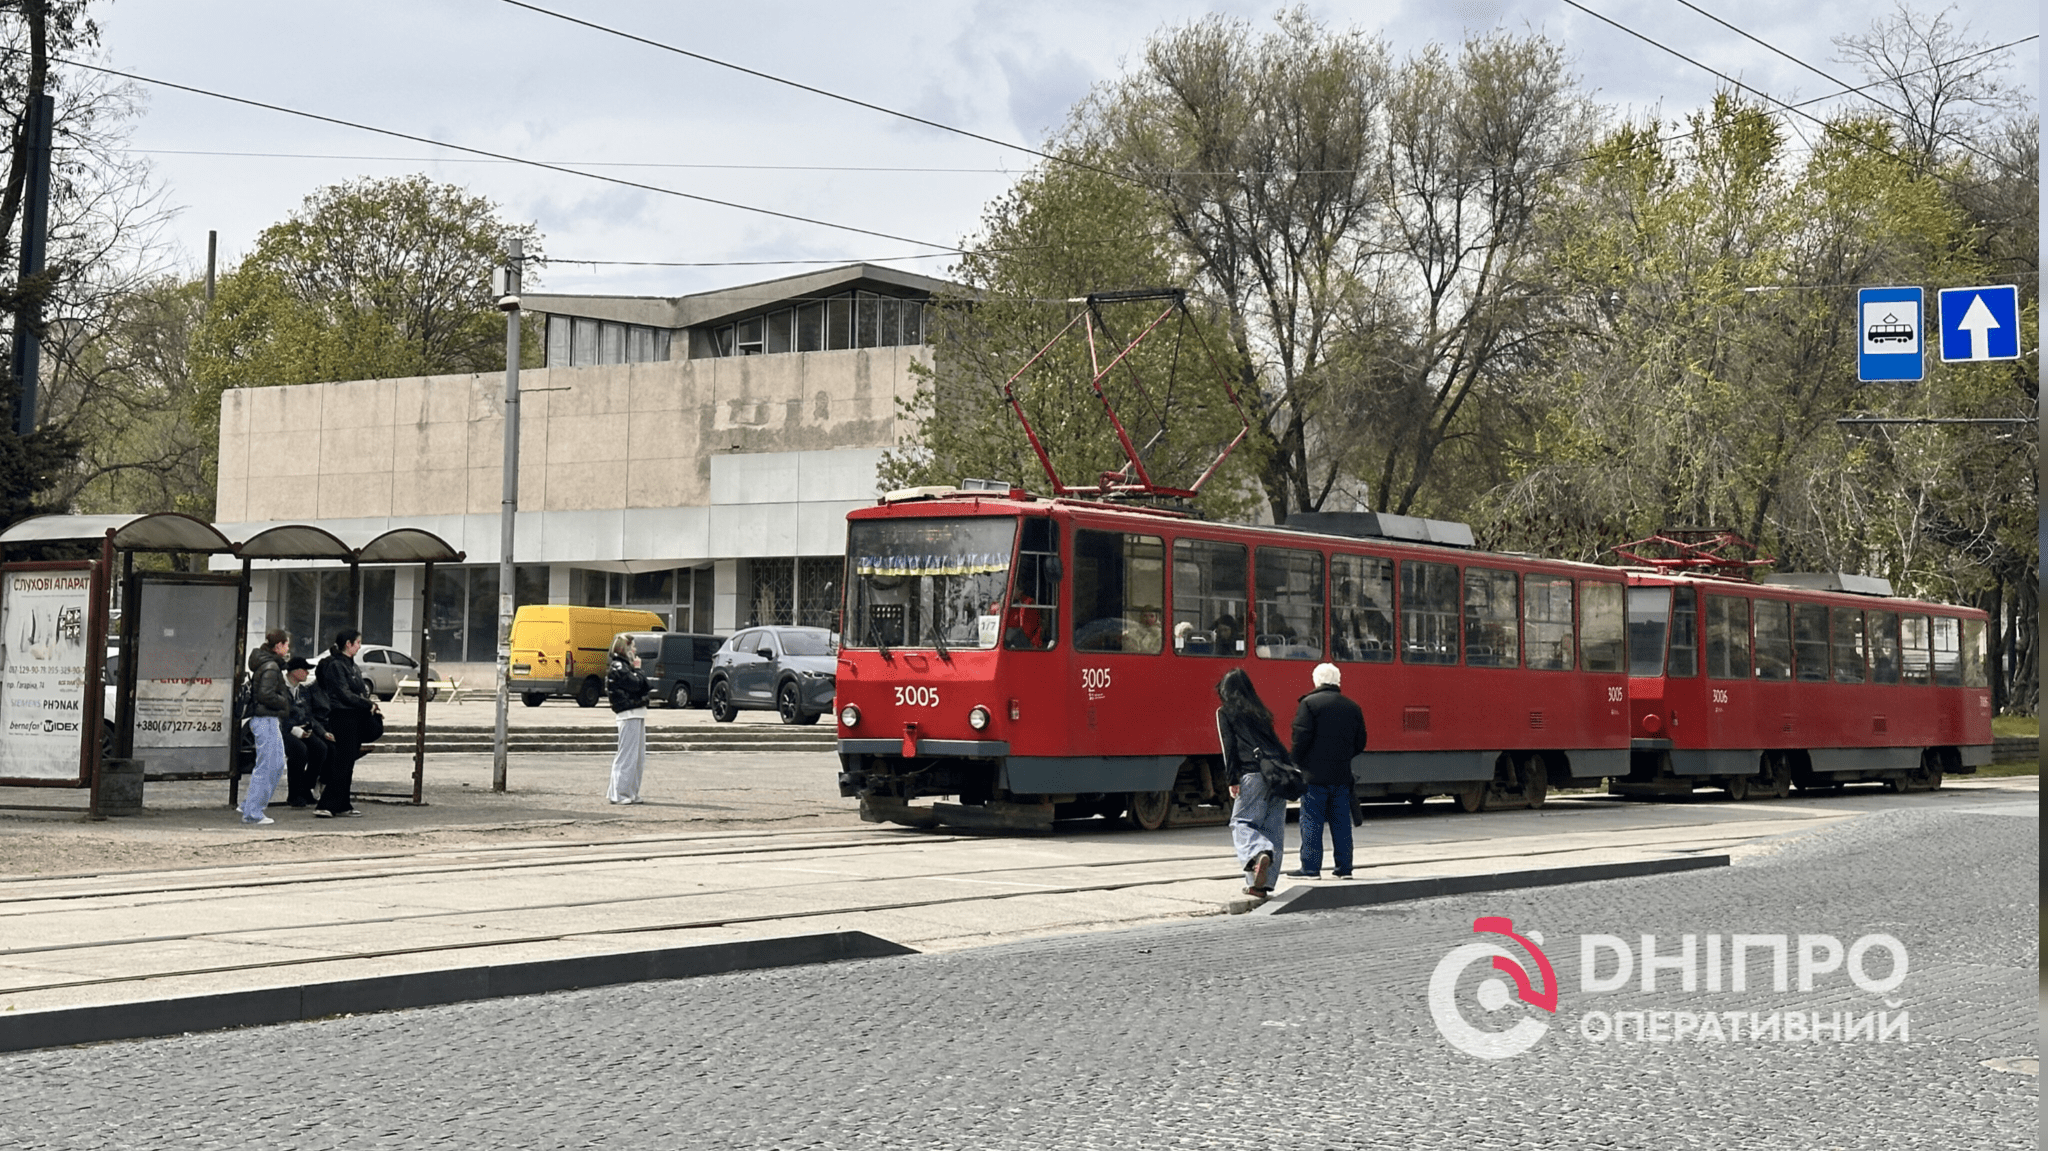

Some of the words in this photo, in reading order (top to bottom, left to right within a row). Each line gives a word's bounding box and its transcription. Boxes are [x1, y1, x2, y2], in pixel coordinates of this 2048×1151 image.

[13, 578, 53, 592] СЛУХОВІ
[981, 621, 997, 631] 1/7
[1082, 668, 1111, 689] 3005
[894, 685, 940, 708] 3005
[1608, 686, 1623, 702] 3005
[1712, 689, 1728, 703] 3006
[43, 700, 79, 711] PHONAK
[43, 719, 79, 733] WIDEX
[136, 720, 222, 734] +380(67)277-26-28
